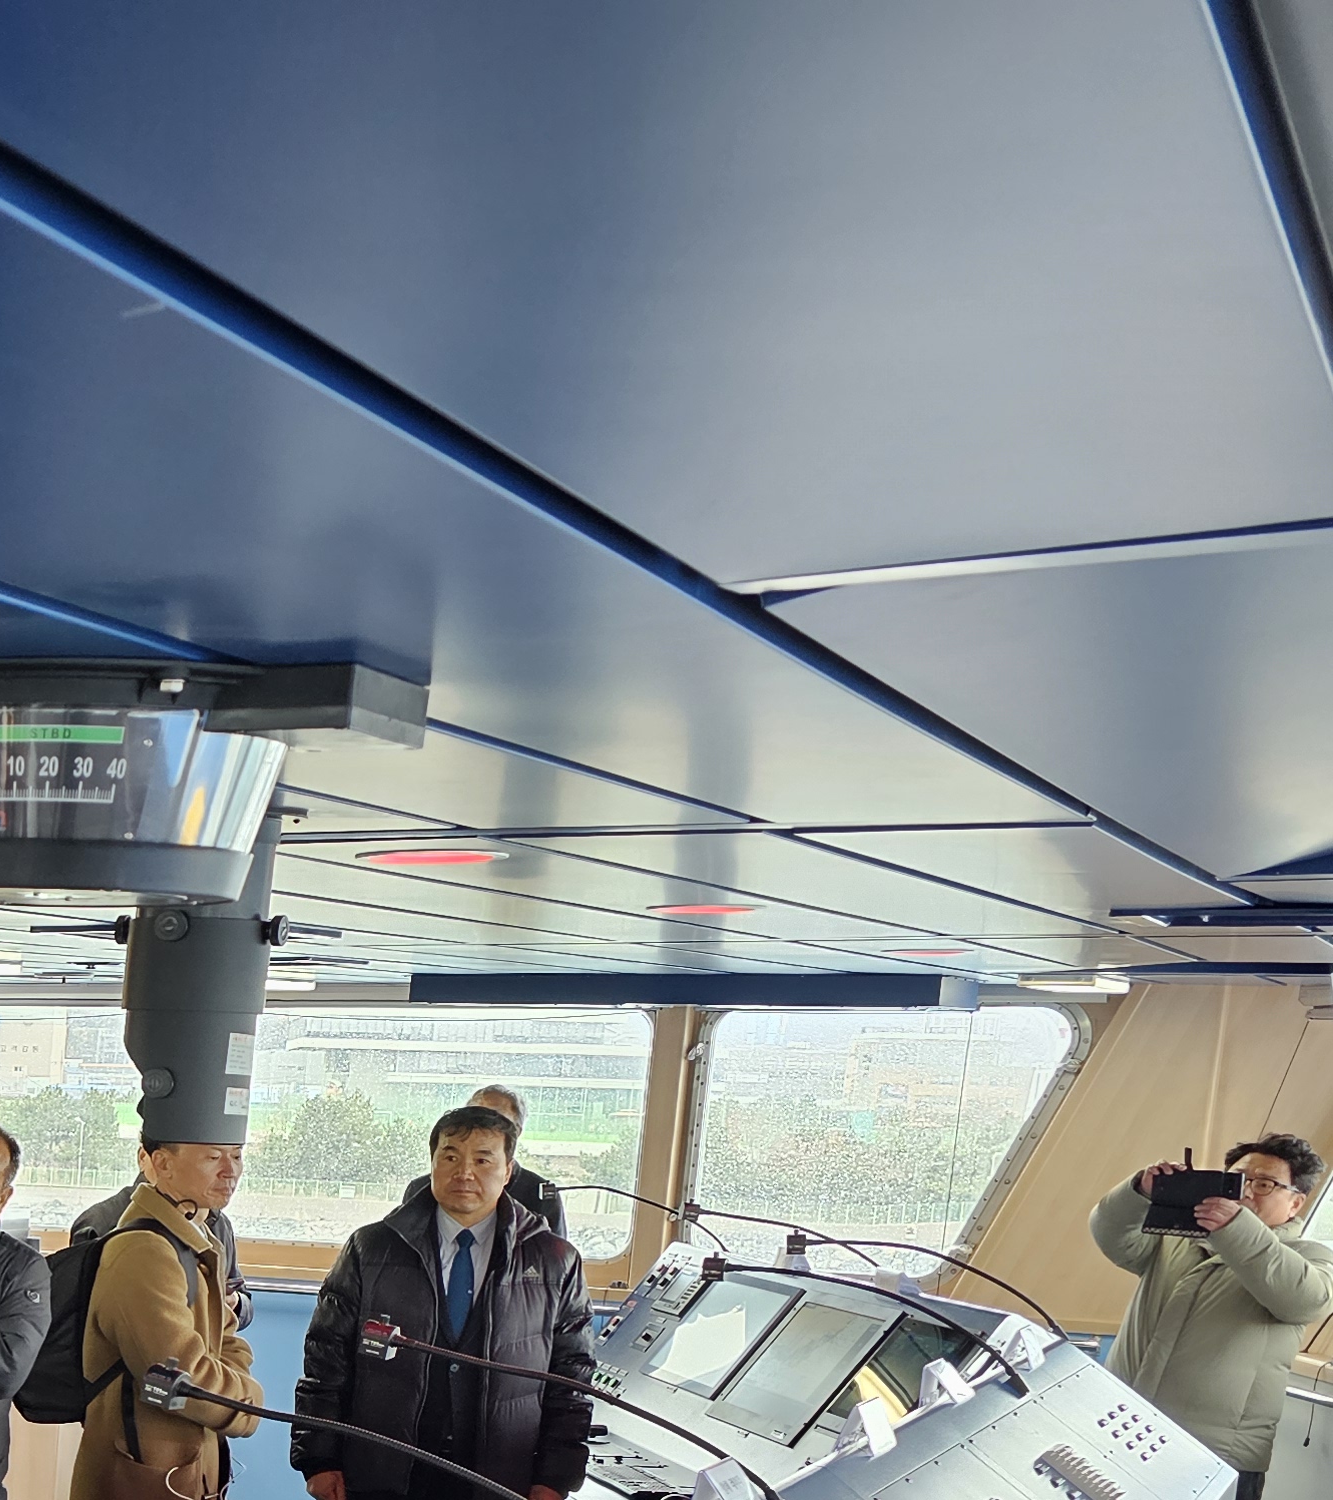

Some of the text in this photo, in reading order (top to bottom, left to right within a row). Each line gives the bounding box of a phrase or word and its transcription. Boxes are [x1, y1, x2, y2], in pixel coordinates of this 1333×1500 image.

[30, 726, 72, 740] STBD
[7, 755, 25, 777] 10
[39, 755, 60, 777] 20
[73, 756, 94, 778] 30
[106, 757, 127, 780] 40
